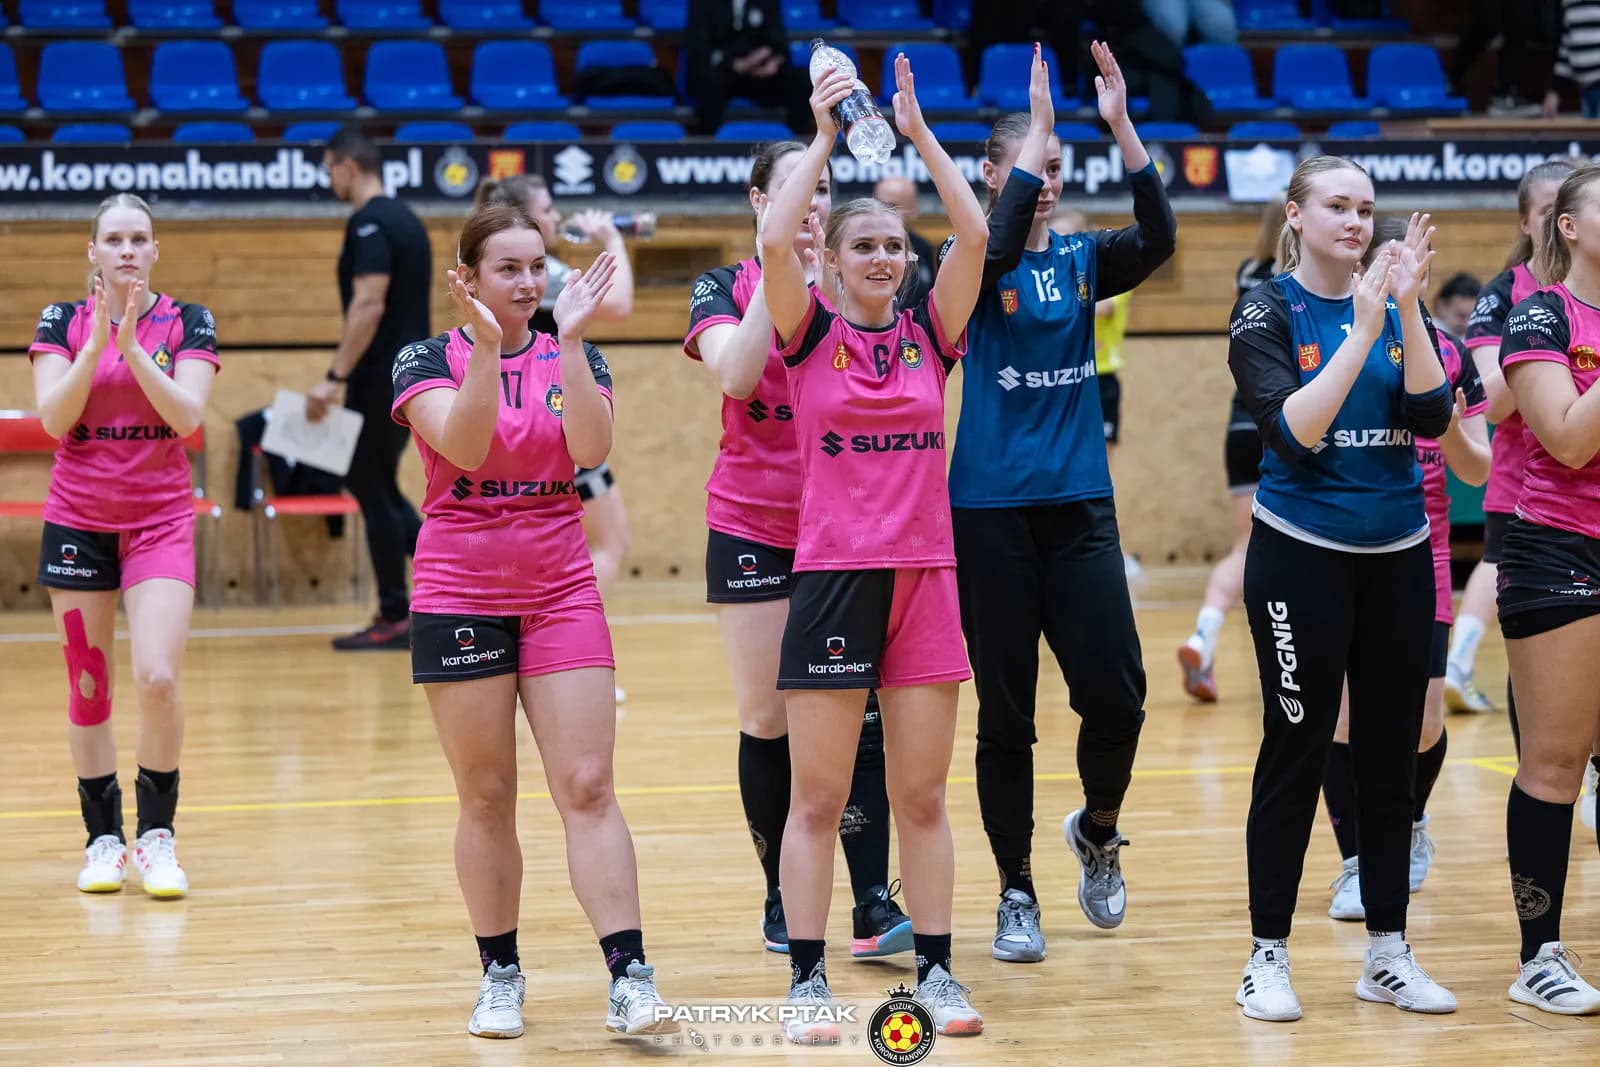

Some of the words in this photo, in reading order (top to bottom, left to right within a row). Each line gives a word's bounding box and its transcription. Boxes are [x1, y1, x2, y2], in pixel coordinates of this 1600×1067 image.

[1031, 267, 1062, 302] 12
[1230, 321, 1267, 339] Horizon
[1508, 314, 1527, 327] Sun
[1509, 322, 1552, 336] Horizon
[873, 344, 890, 378] 6
[501, 370, 522, 409] 17
[851, 431, 945, 453] SUZUKI
[1333, 428, 1412, 448] SUZUKI
[726, 575, 781, 589] karabela
[1267, 601, 1301, 692] PGNiG
[441, 649, 500, 668] karabela
[808, 661, 865, 674] karabela
